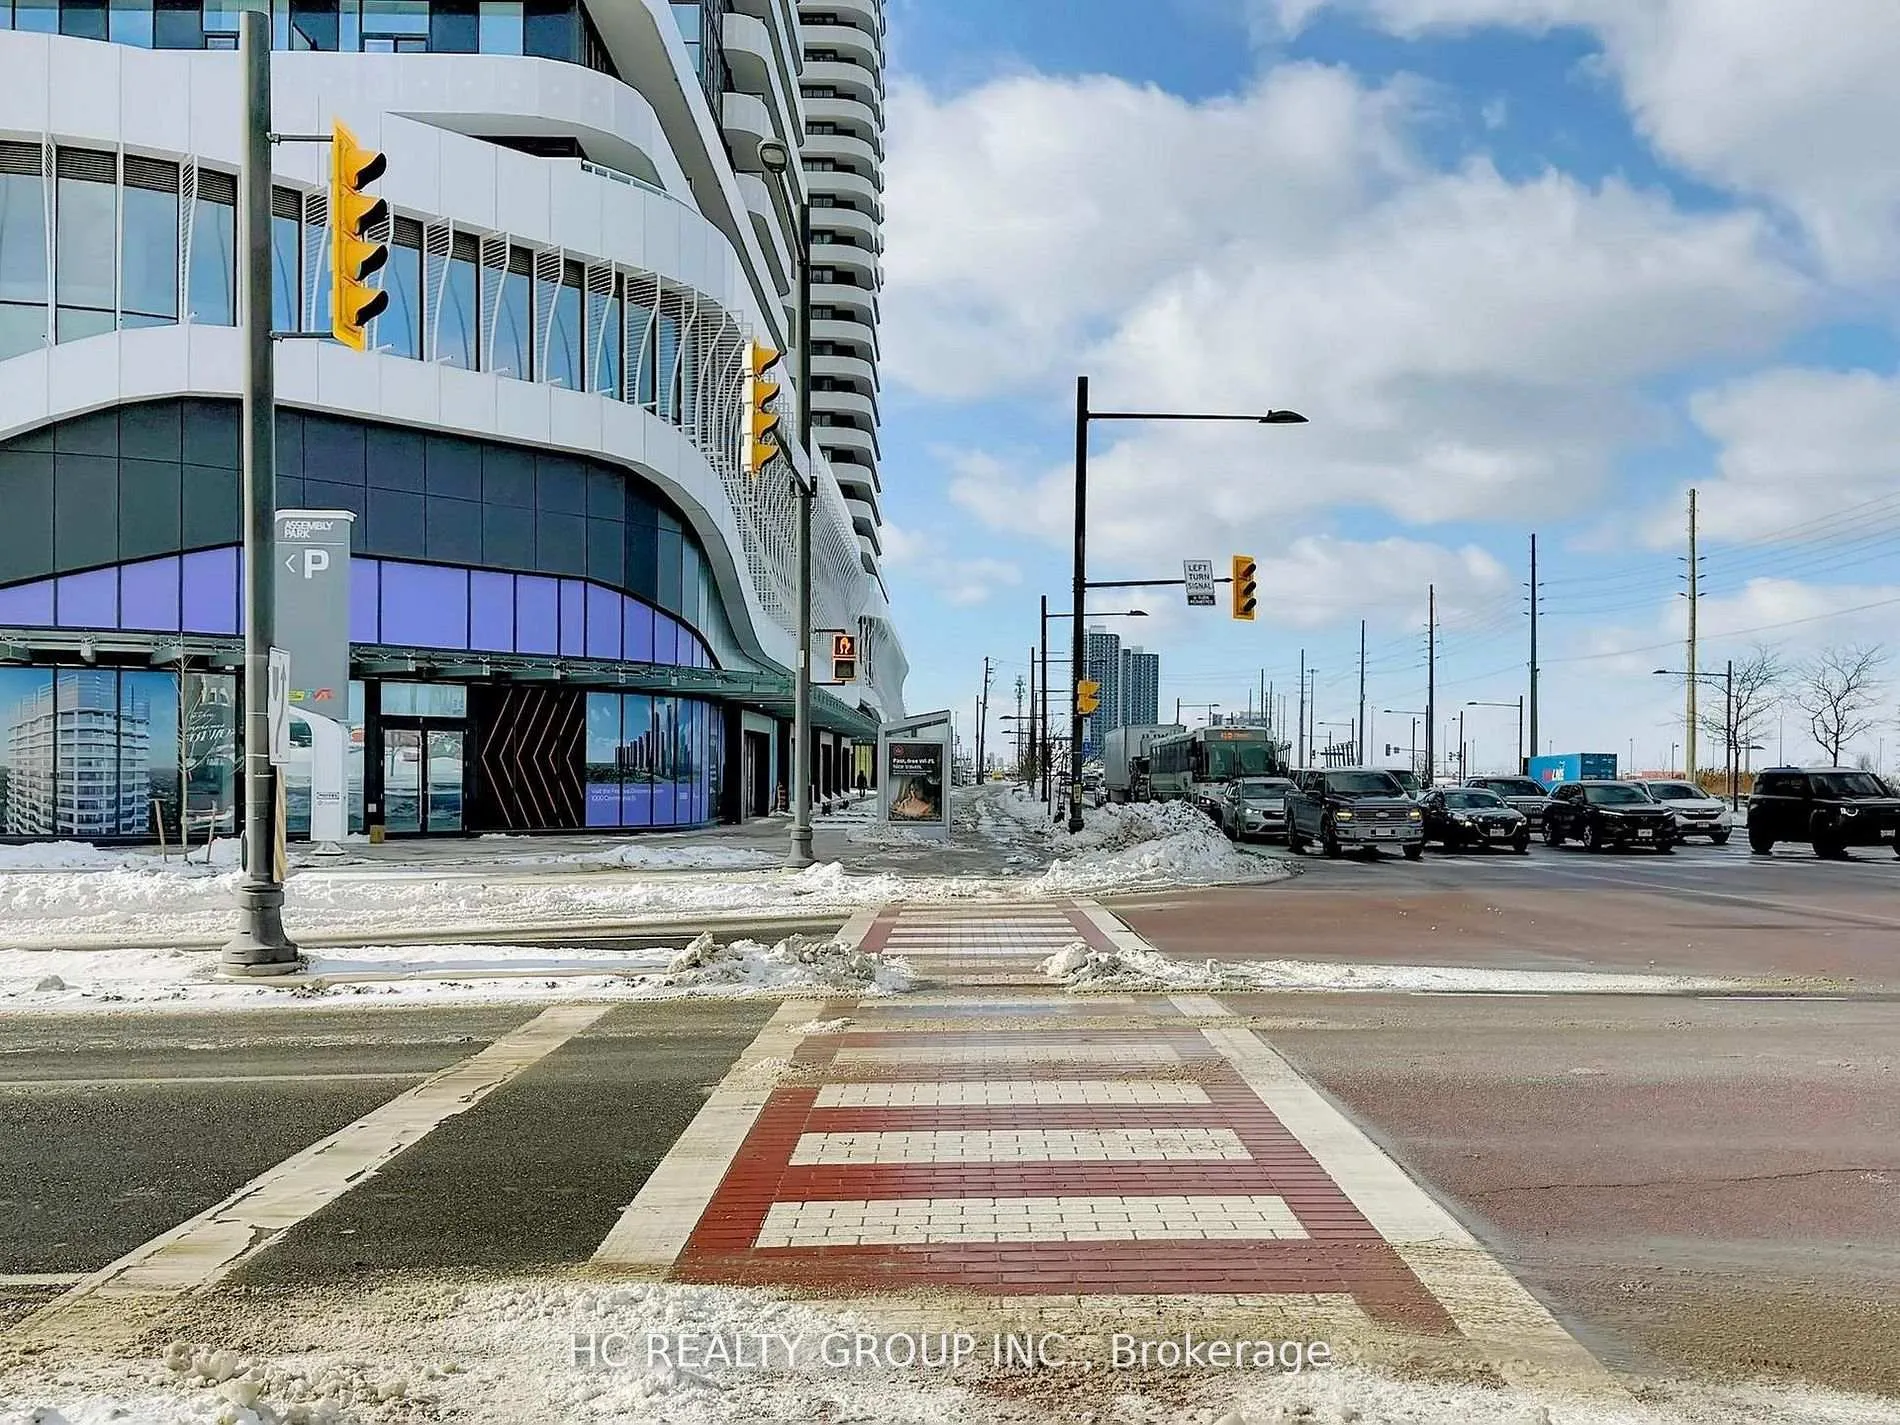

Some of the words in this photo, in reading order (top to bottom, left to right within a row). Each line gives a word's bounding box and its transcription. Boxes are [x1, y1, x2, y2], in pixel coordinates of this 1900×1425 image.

[284, 520, 334, 531] ASSEMBLY
[284, 528, 312, 539] PARK
[304, 549, 329, 579] P
[1188, 564, 1207, 572] LEFT
[1189, 573, 1210, 581] TURN
[1188, 582, 1212, 590] SIGNAL
